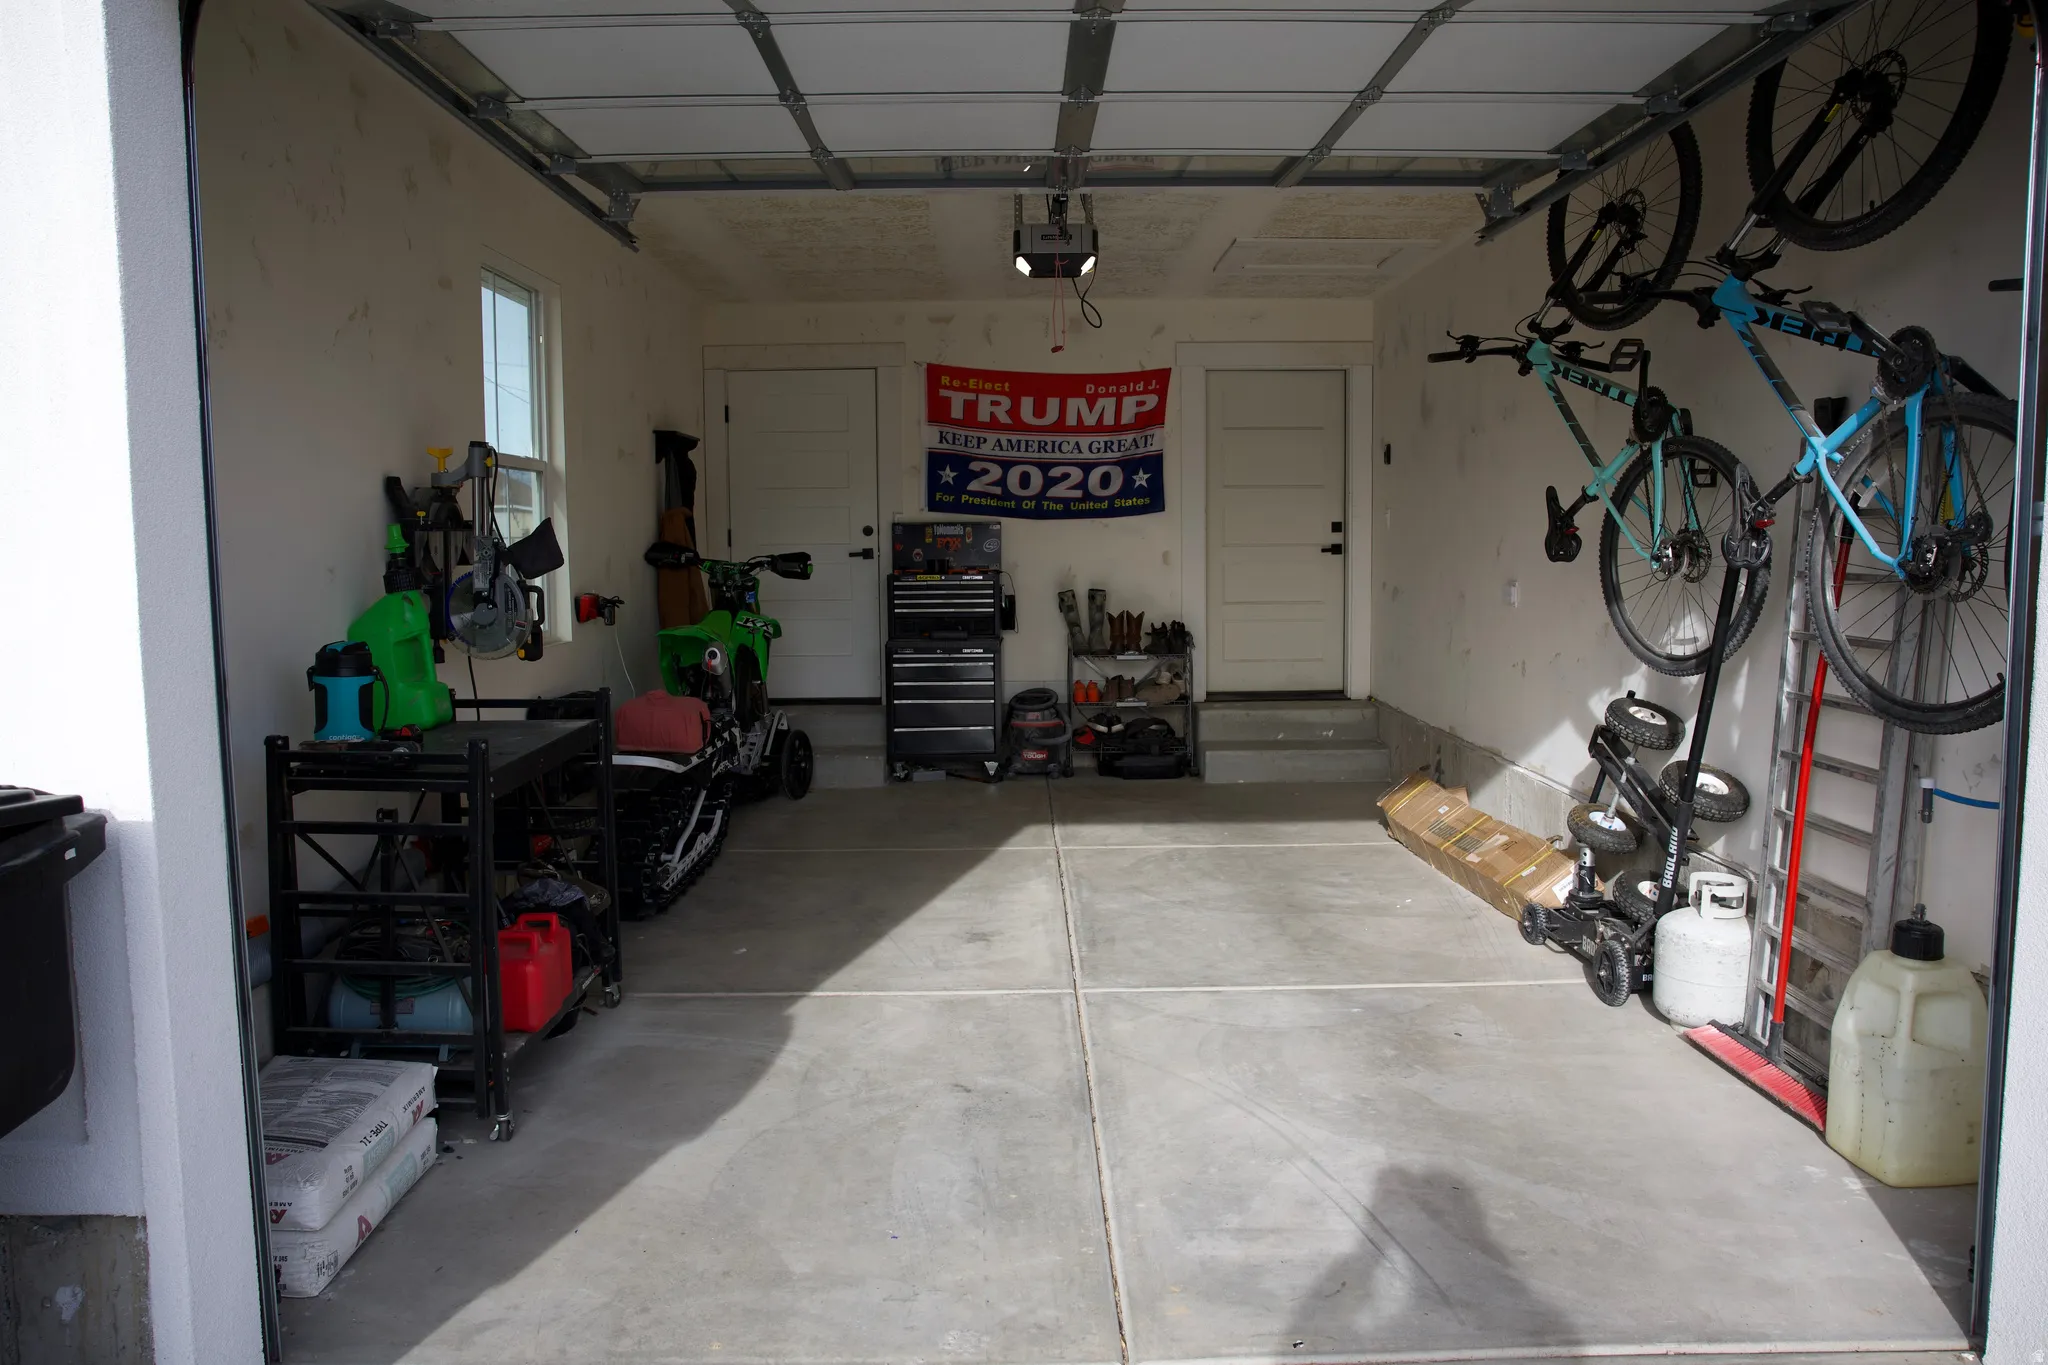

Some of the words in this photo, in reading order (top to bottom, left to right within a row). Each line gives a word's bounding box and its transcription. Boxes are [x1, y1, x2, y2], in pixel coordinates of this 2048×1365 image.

[941, 376, 1010, 392] Re-Elect
[1085, 381, 1144, 394] Donald
[1147, 380, 1160, 390] J.
[1549, 360, 1634, 408] TREK
[939, 389, 1159, 427] TRUMP
[938, 431, 987, 449] KEEP
[991, 438, 1083, 454] AMERICA
[1088, 433, 1155, 454] GREAT!
[966, 461, 1123, 498] 2020
[935, 492, 955, 502] For
[961, 494, 1016, 509] President
[1022, 500, 1036, 509] Of
[1042, 501, 1064, 510] The
[1070, 501, 1108, 510] United
[1114, 496, 1151, 507] States
[1662, 826, 1678, 888] BADLAND
[1582, 934, 1598, 955] BAD
[1642, 973, 1653, 982] BA
[402, 1086, 426, 1113] AMERIMIX
[265, 1146, 304, 1154] AMERIMI
